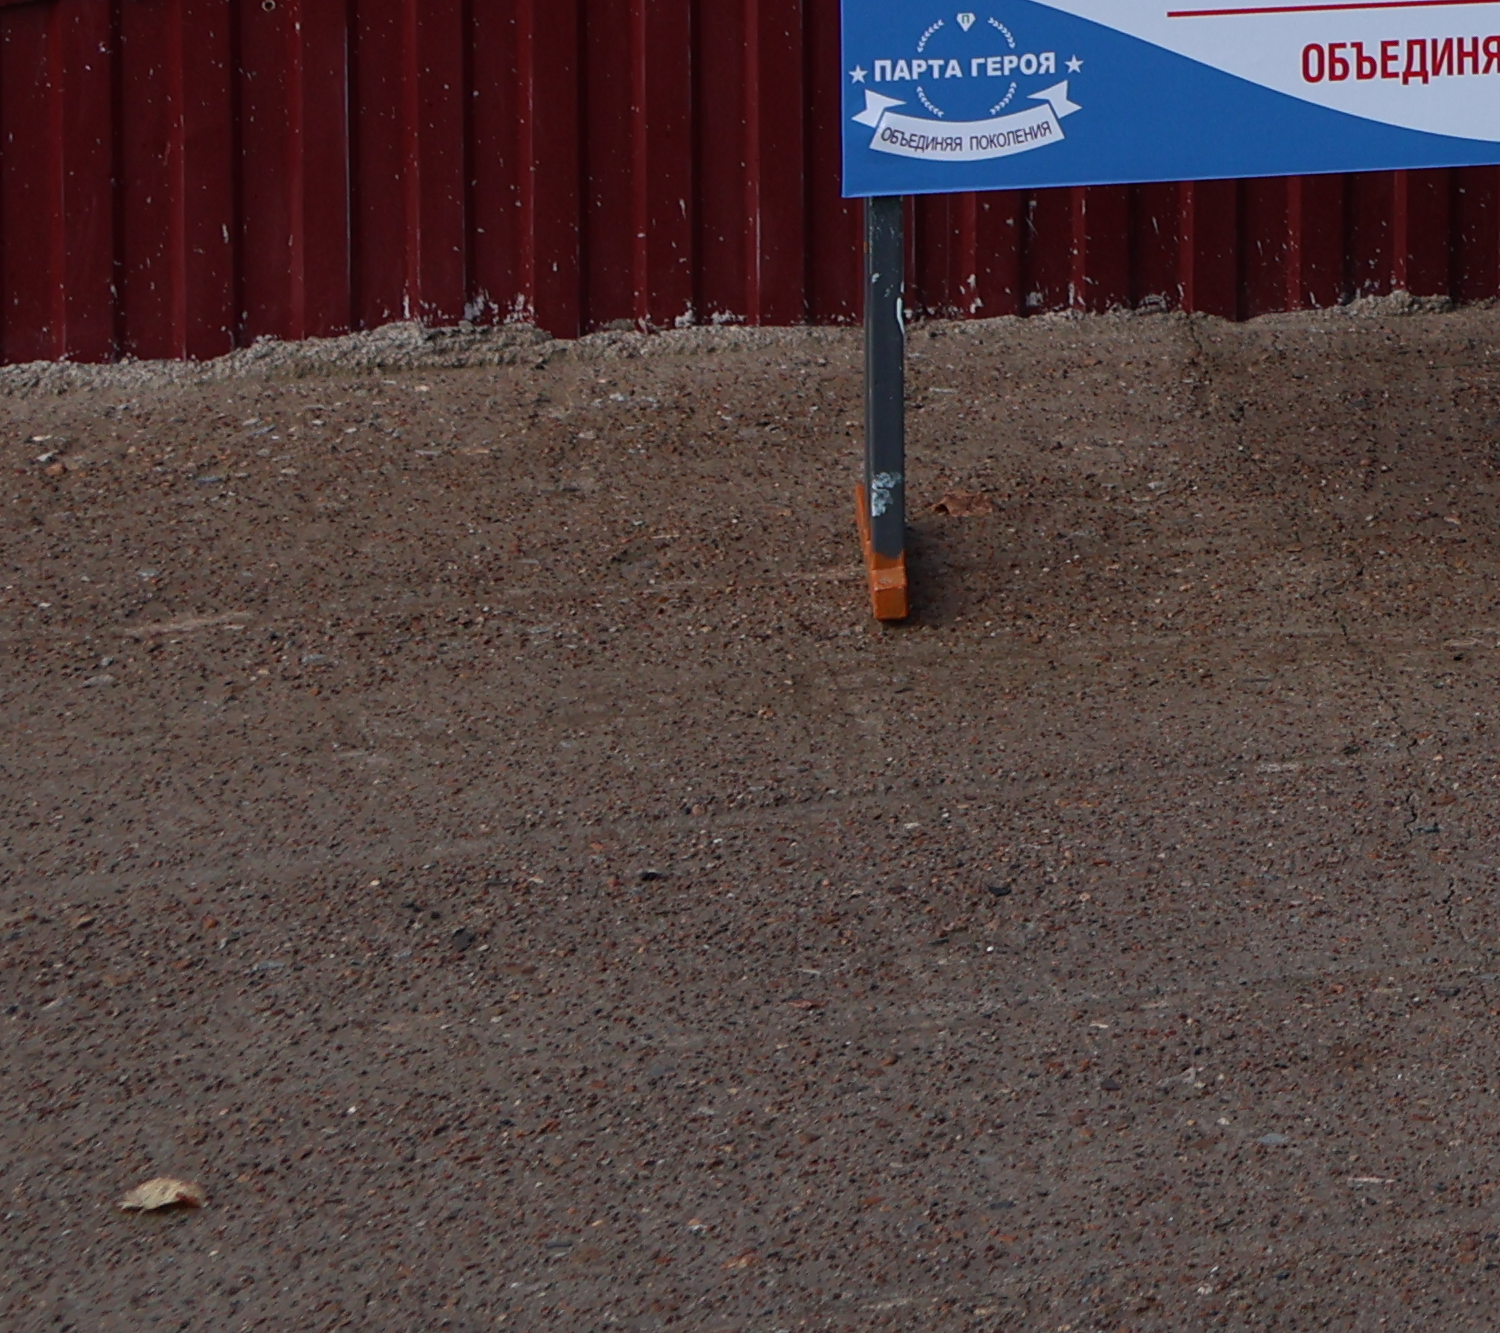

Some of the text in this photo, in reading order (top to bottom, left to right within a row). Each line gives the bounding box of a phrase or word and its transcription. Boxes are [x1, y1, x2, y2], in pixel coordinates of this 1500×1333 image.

[874, 52, 1056, 82] ПАРТА ГЕРОЯ
[880, 120, 1052, 153] ОБЪЕДИНЯЯ ПОКОЛЕНИЯ
